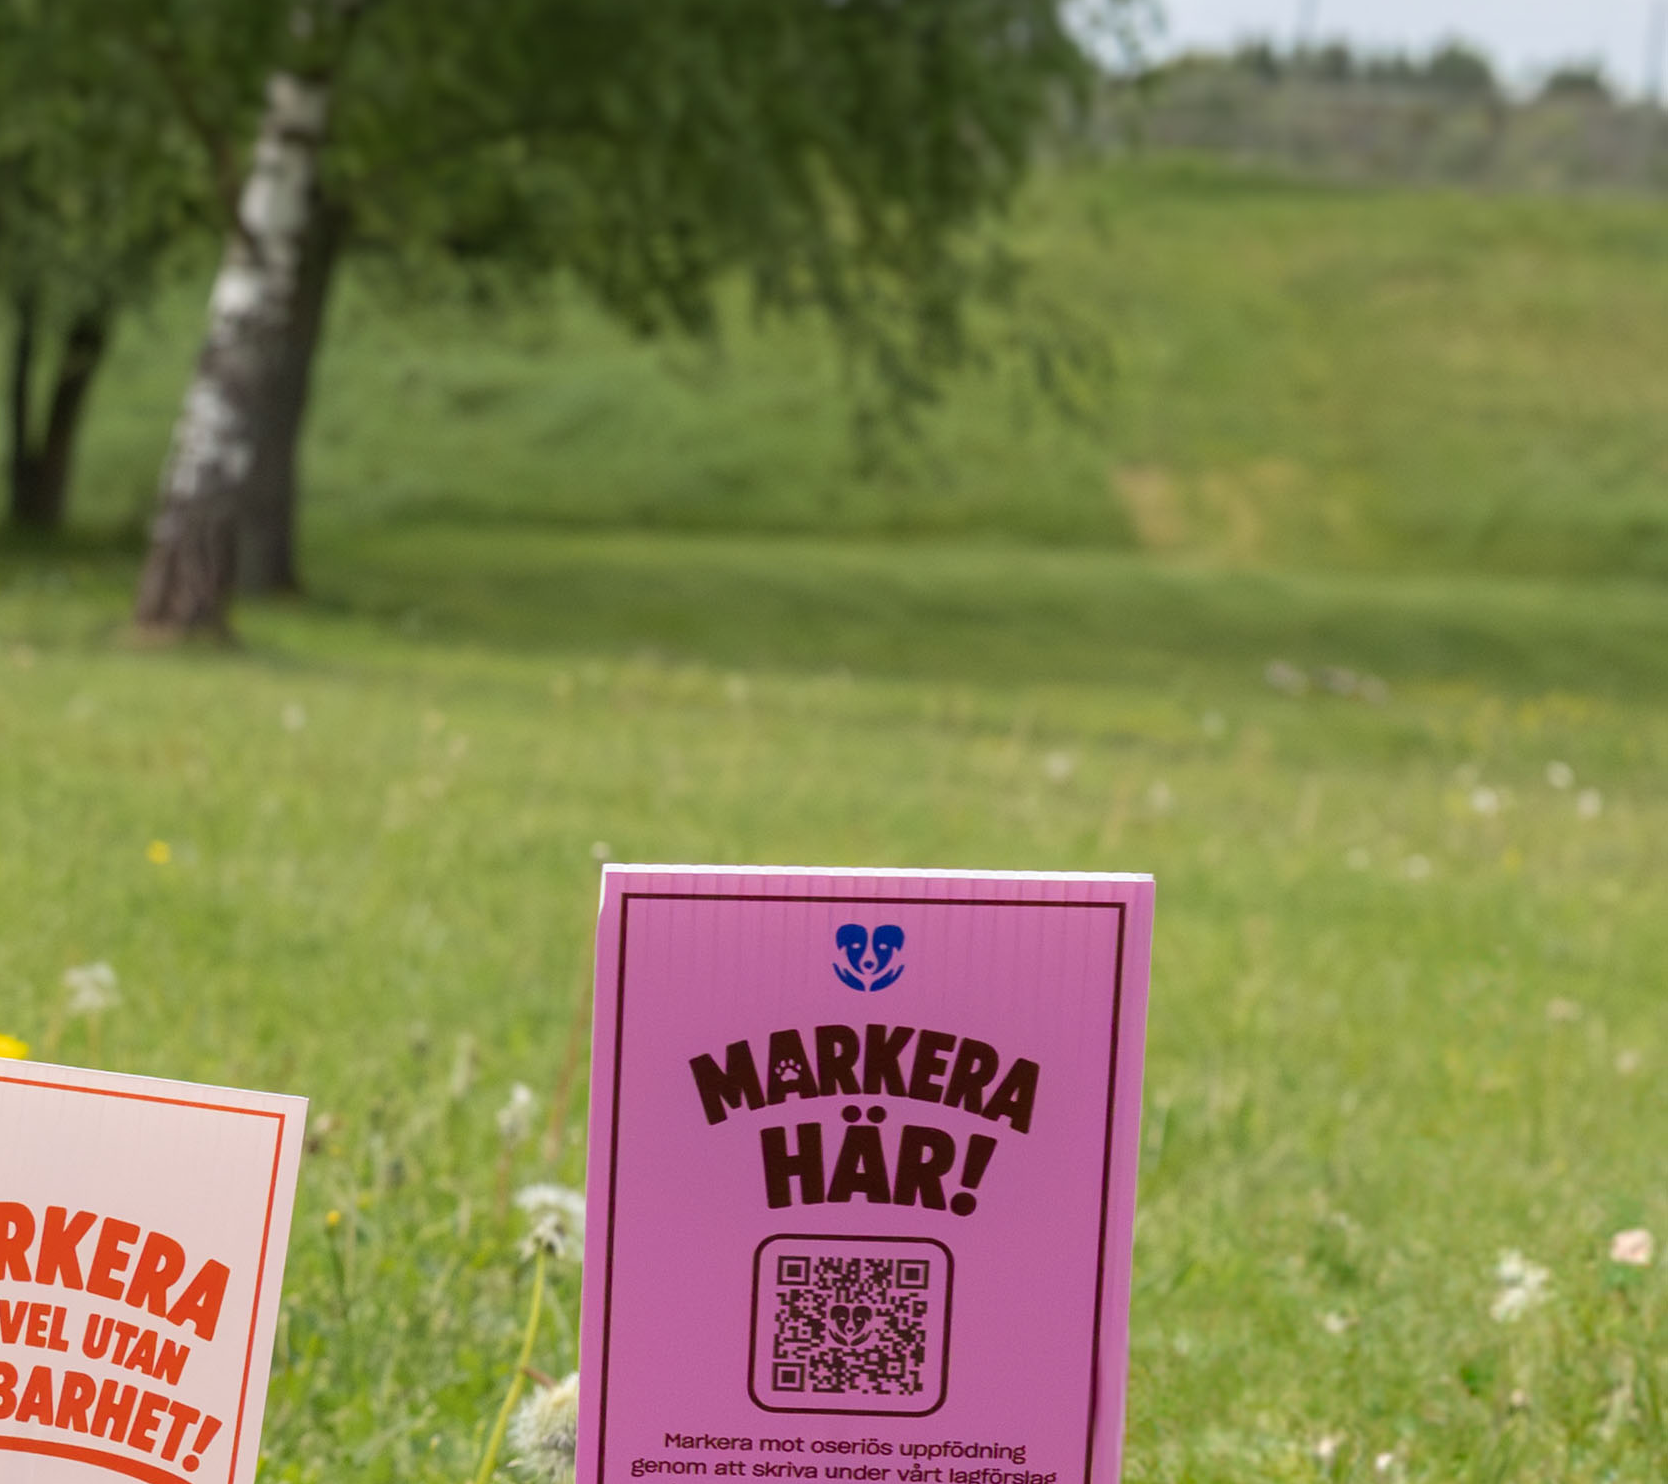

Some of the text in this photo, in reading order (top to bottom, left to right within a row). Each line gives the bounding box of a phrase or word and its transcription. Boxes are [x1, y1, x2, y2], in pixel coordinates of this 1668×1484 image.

[689, 1024, 1039, 1134] MARKERA
[760, 1105, 997, 1216] HÄR!
[82, 1314, 190, 1385] UTAN
[631, 1458, 707, 1477] genom
[714, 1461, 746, 1476] att
[752, 1462, 817, 1478] skriva
[825, 1465, 891, 1481] under
[897, 1463, 943, 1483] vårt
[665, 1433, 1026, 1464] Markera mot oseriös uppfödning
